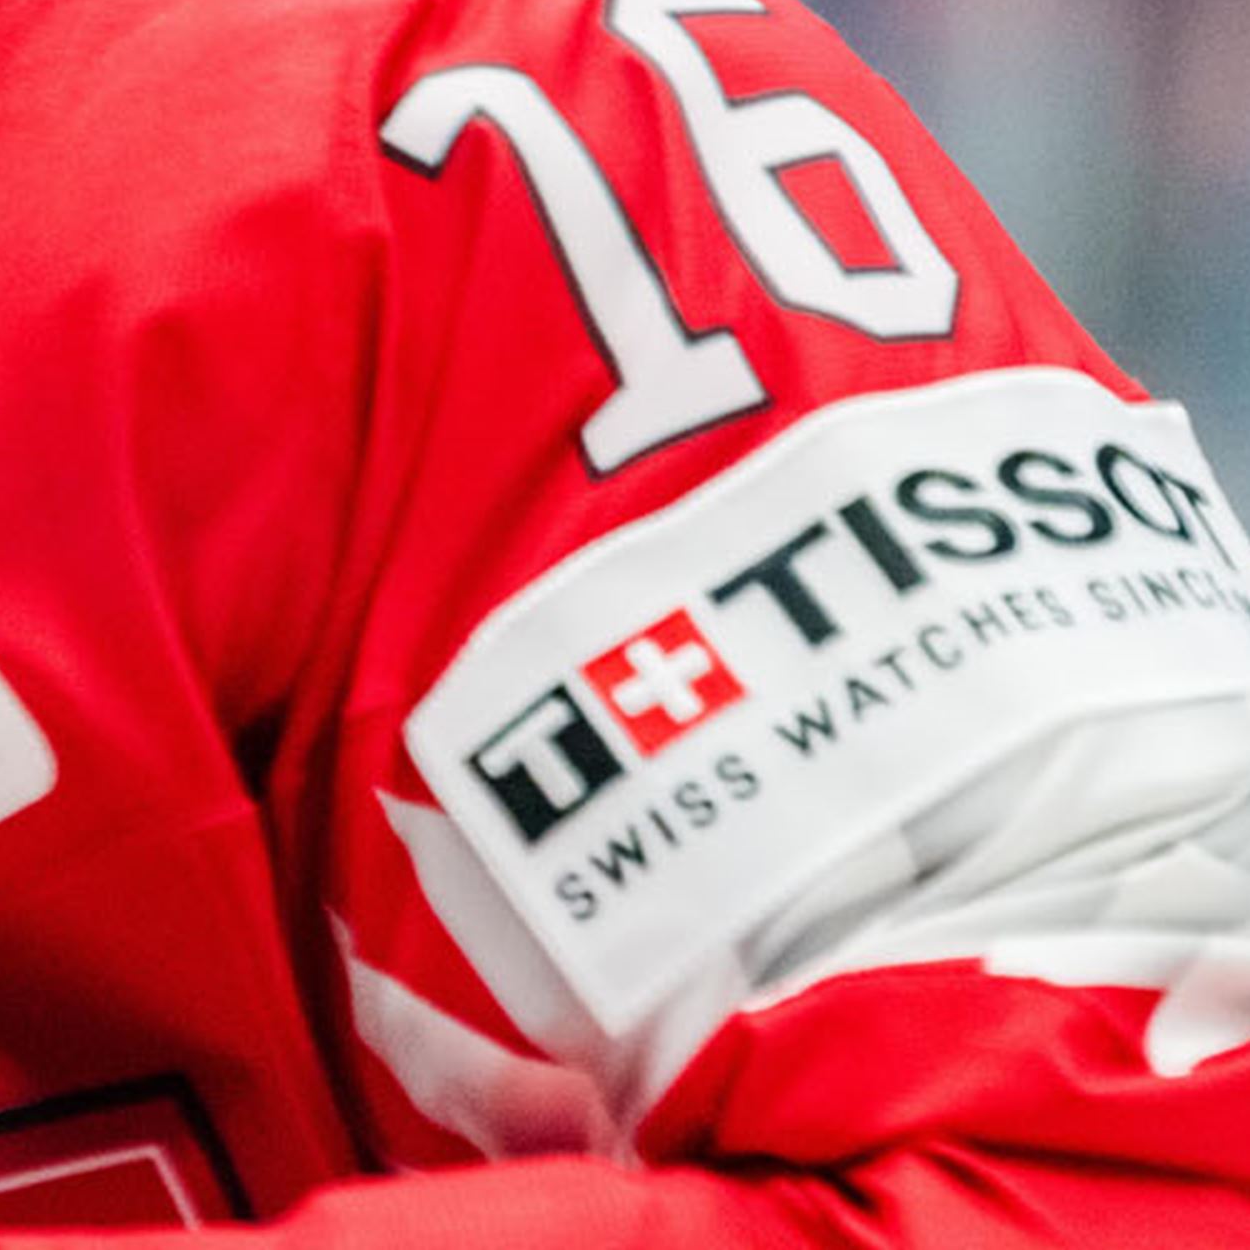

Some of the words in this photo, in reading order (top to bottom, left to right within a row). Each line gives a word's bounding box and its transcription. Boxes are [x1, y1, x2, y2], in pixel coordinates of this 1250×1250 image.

[706, 442, 1238, 648] TISSOT
[553, 753, 762, 922] SWISS
[772, 587, 1076, 759] WATCHES
